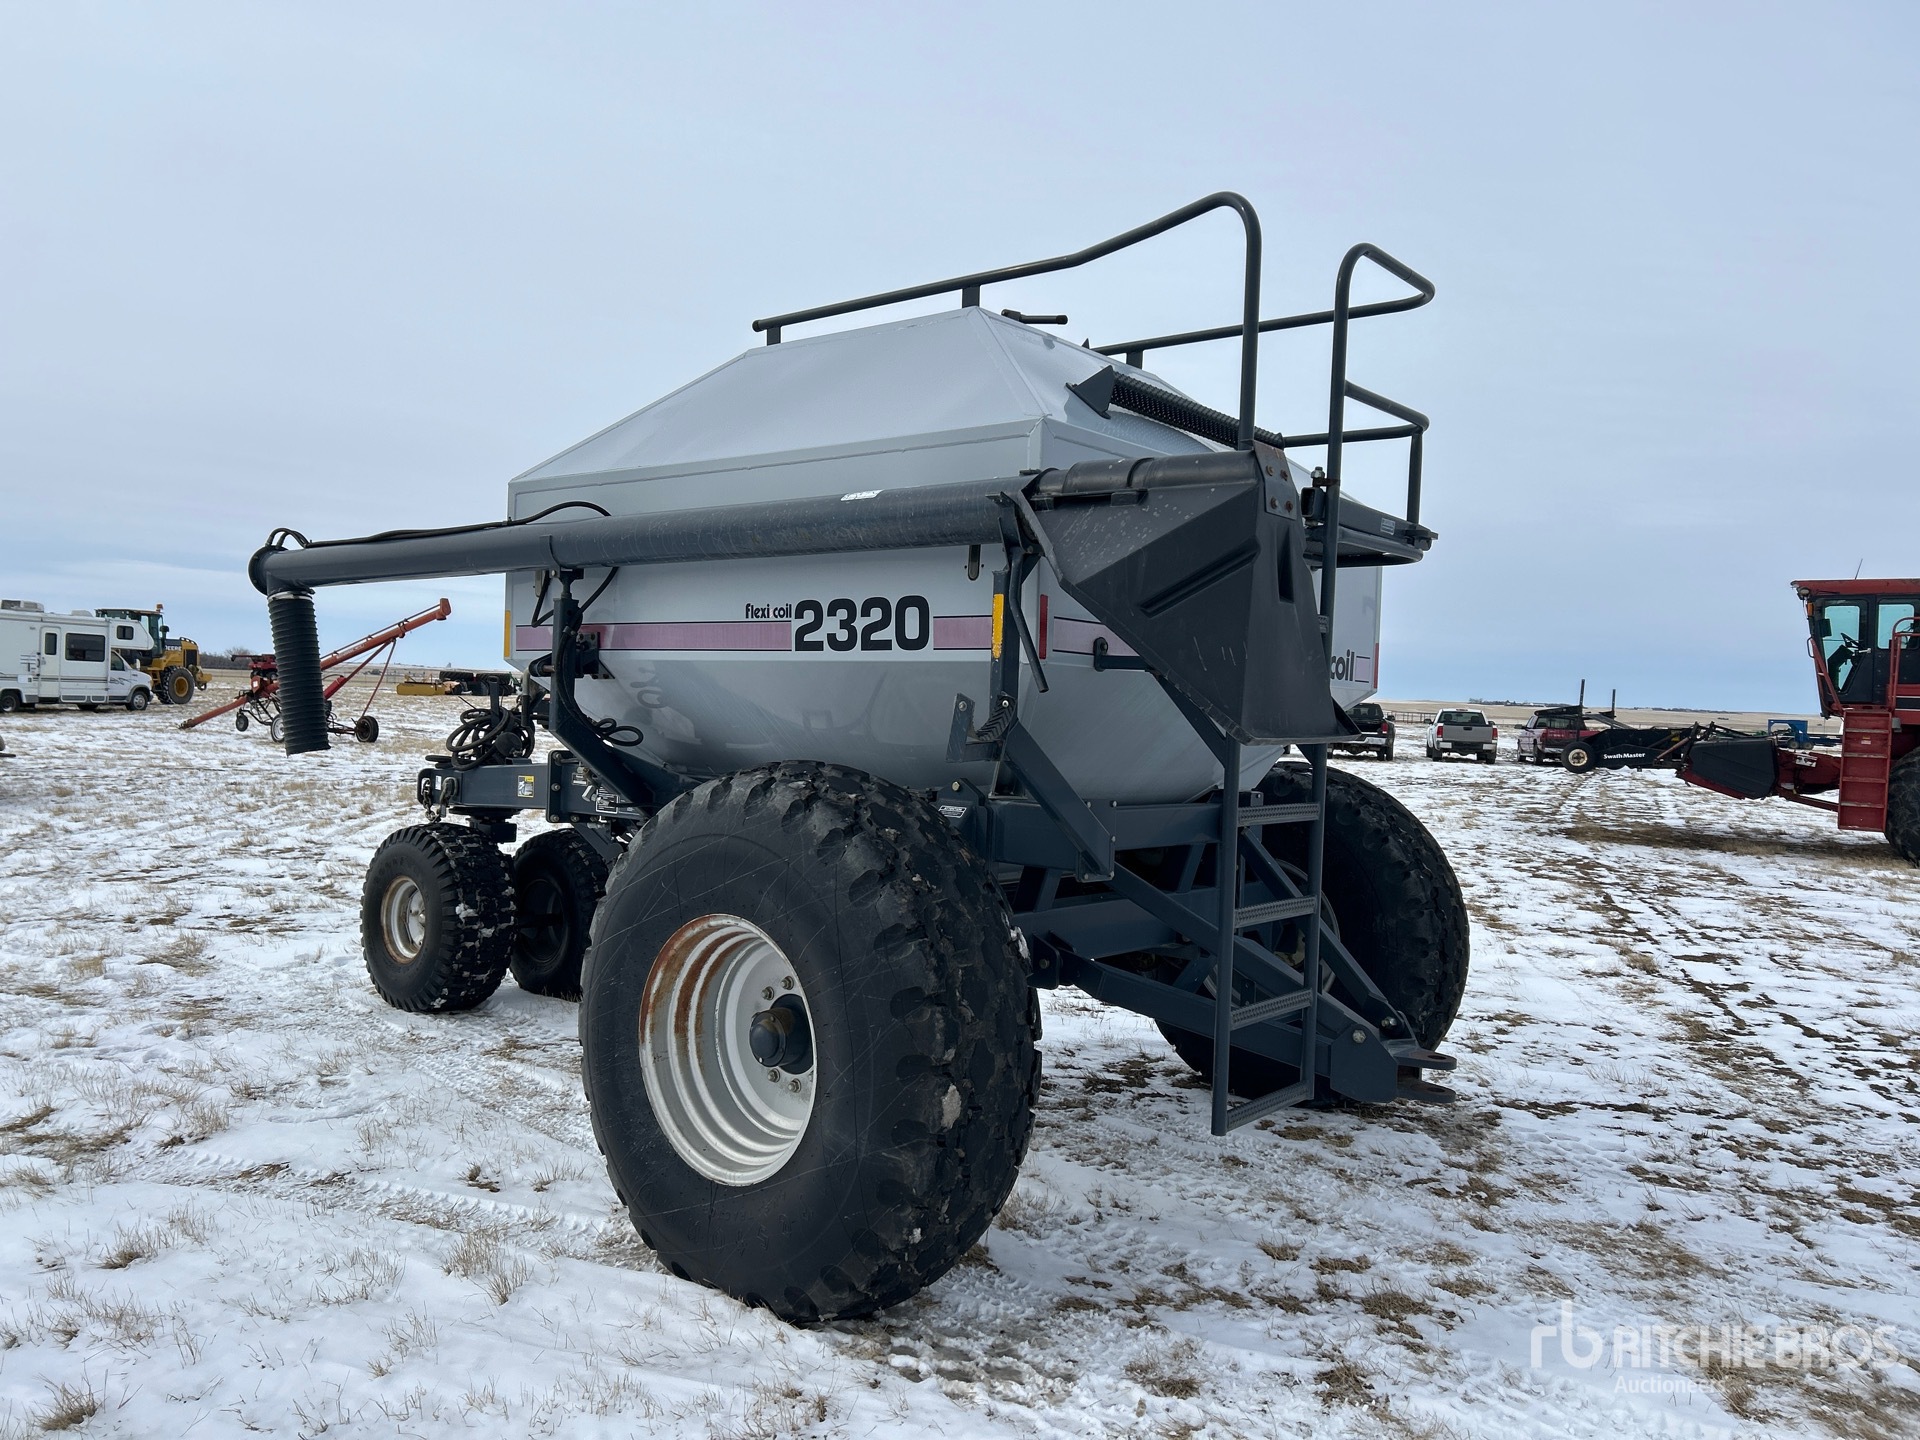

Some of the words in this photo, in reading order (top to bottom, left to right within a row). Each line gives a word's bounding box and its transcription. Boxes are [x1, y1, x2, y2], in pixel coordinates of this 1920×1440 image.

[745, 603, 770, 619] flexi
[772, 603, 792, 619] coil
[794, 594, 930, 651] 2320
